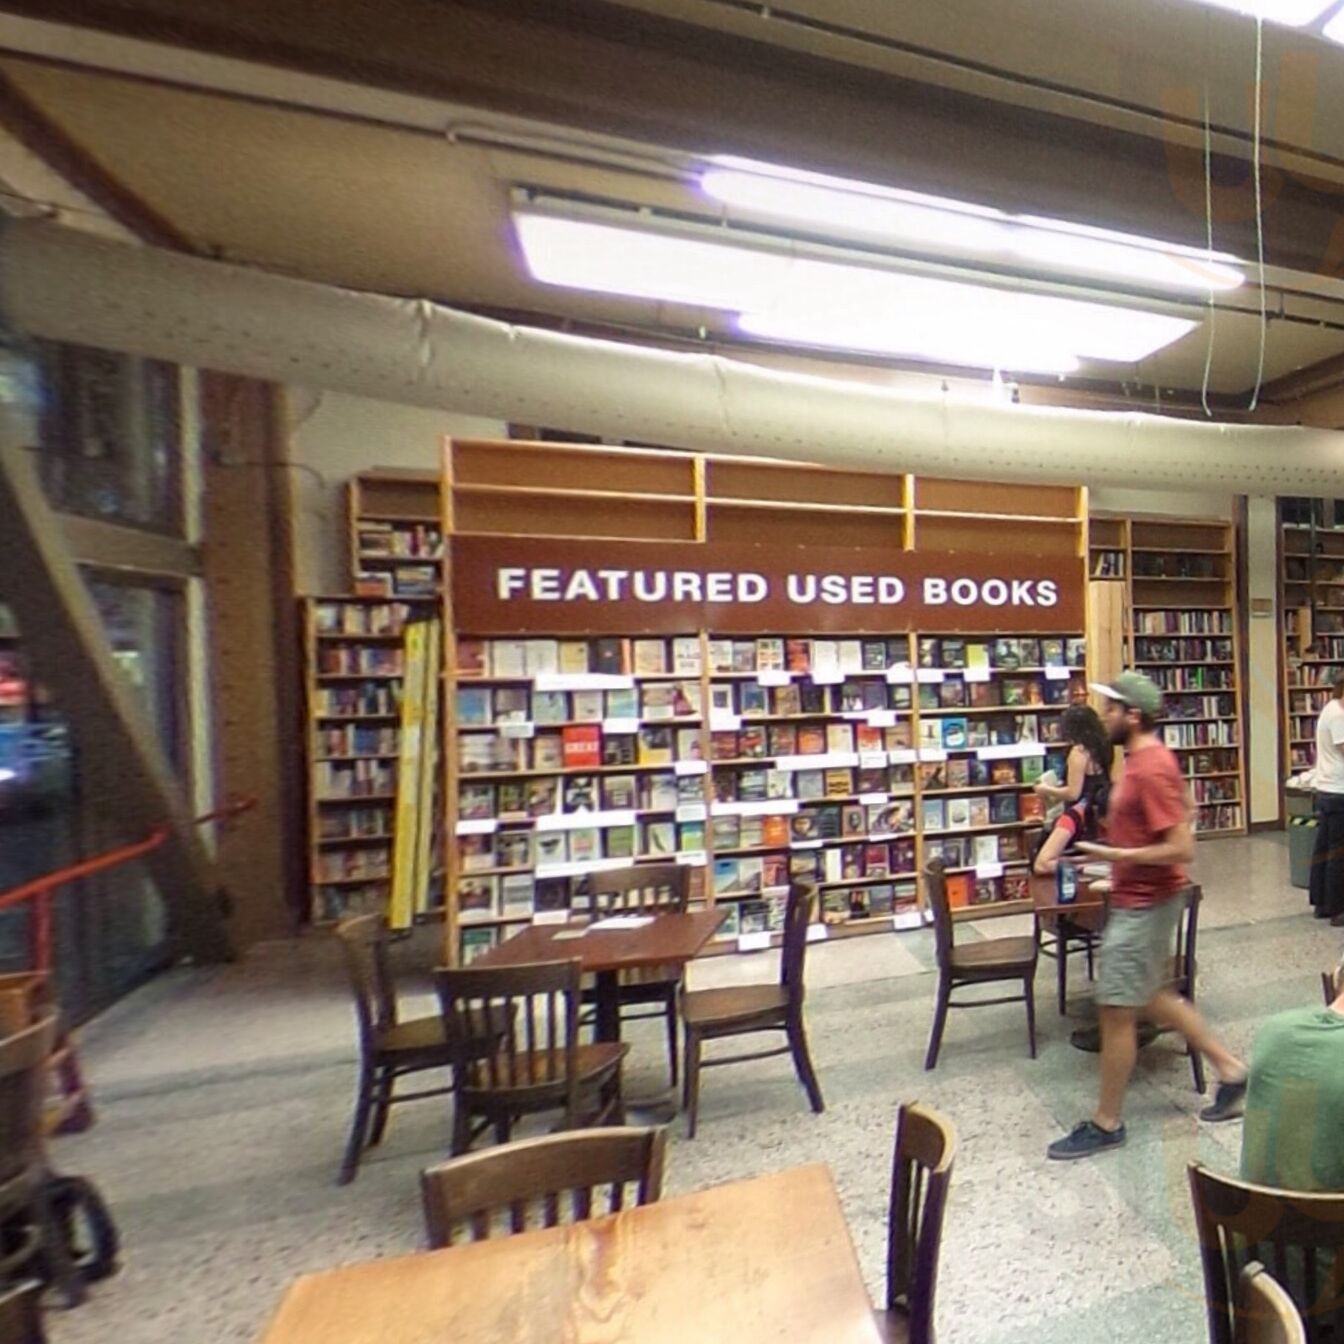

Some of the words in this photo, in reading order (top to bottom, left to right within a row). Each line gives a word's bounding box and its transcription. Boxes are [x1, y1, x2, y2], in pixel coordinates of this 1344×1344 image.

[497, 568, 768, 603] FEATURED
[786, 574, 904, 604] USED
[922, 577, 1058, 607] BOOKS
